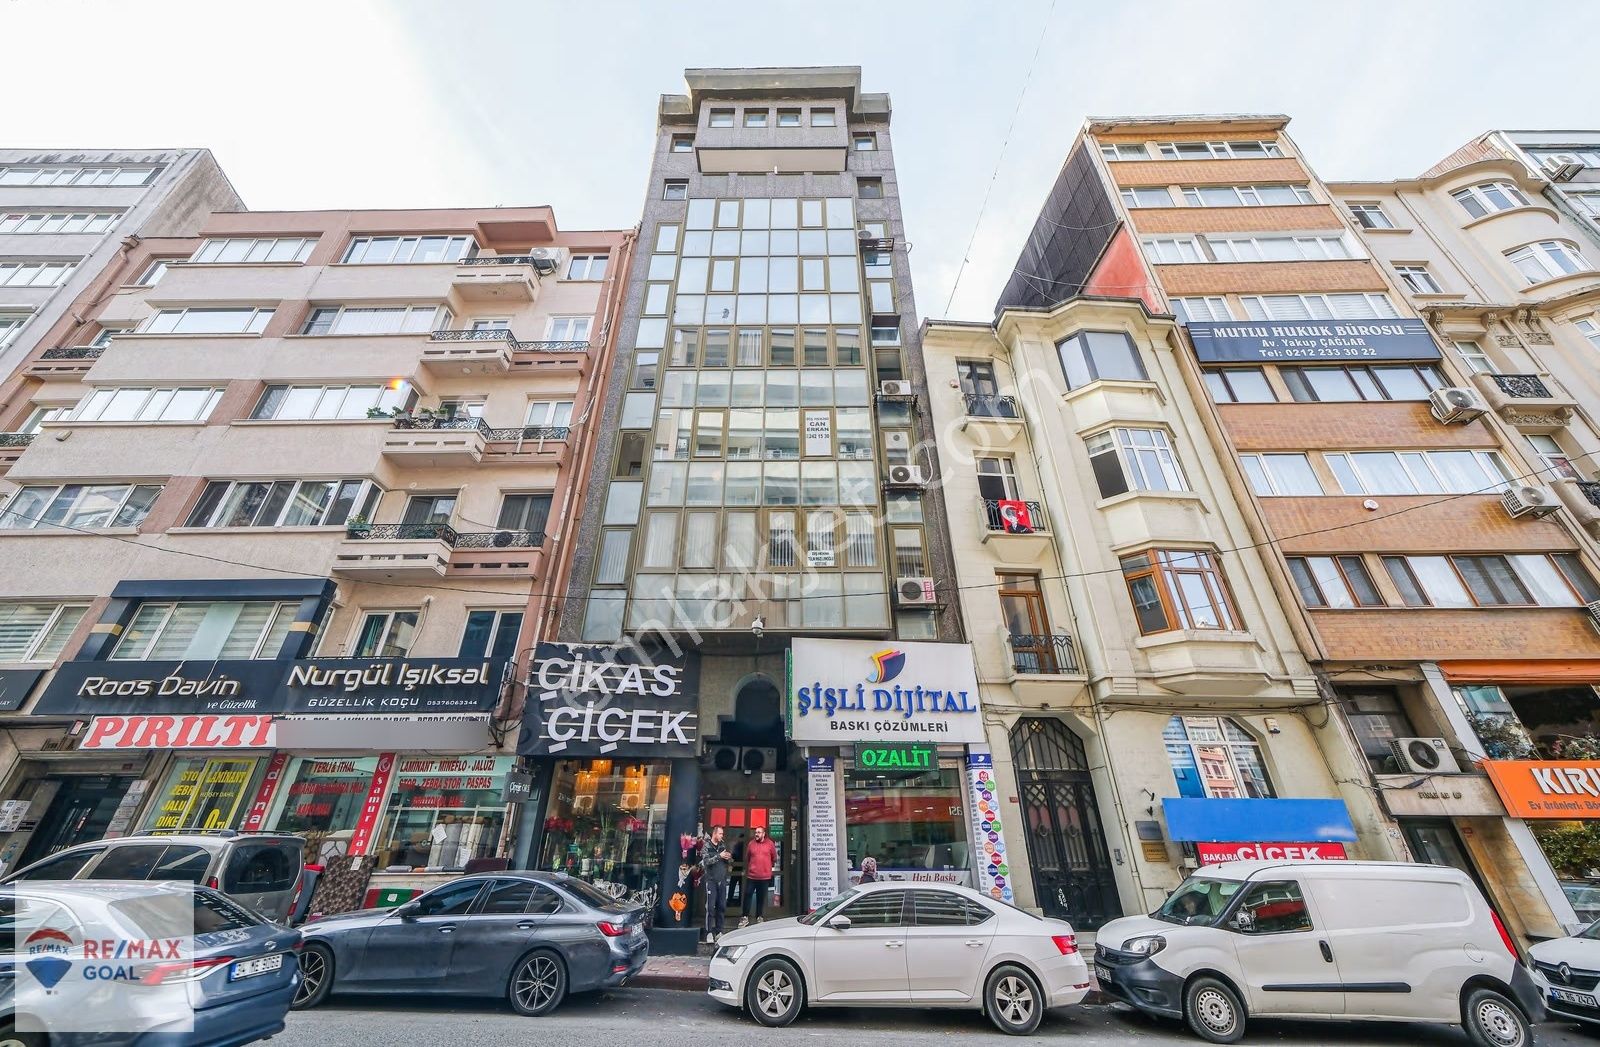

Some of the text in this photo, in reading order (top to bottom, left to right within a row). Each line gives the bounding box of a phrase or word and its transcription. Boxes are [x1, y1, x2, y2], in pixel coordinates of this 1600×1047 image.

[1213, 323, 1405, 339] MUTLU HUKUK BÜROSU
[1262, 336, 1366, 349] Av. Yakup ÇAĞLAR
[1259, 348, 1377, 358] Tel: 0212 233 30 22
[286, 662, 490, 692] Nurgül Işıksal
[538, 652, 677, 701] ÇİKAS
[76, 674, 239, 697] Roos Davin
[206, 699, 259, 710] ve Güzellik
[308, 696, 376, 707] GÜZELLİK
[380, 698, 420, 709] KOÇU
[798, 681, 977, 719] ŞİŞLİ DİJİTAL
[83, 715, 273, 748] PIRILTI
[547, 700, 691, 754] ÇİÇEK
[830, 720, 949, 734] BASKI ÇÖZÜMLERİ
[861, 745, 932, 767] OZALİT
[466, 776, 492, 789] PASPAS
[1203, 853, 1240, 861] BAKARA
[912, 872, 931, 882] Hızlı
[933, 872, 957, 882] Baskı
